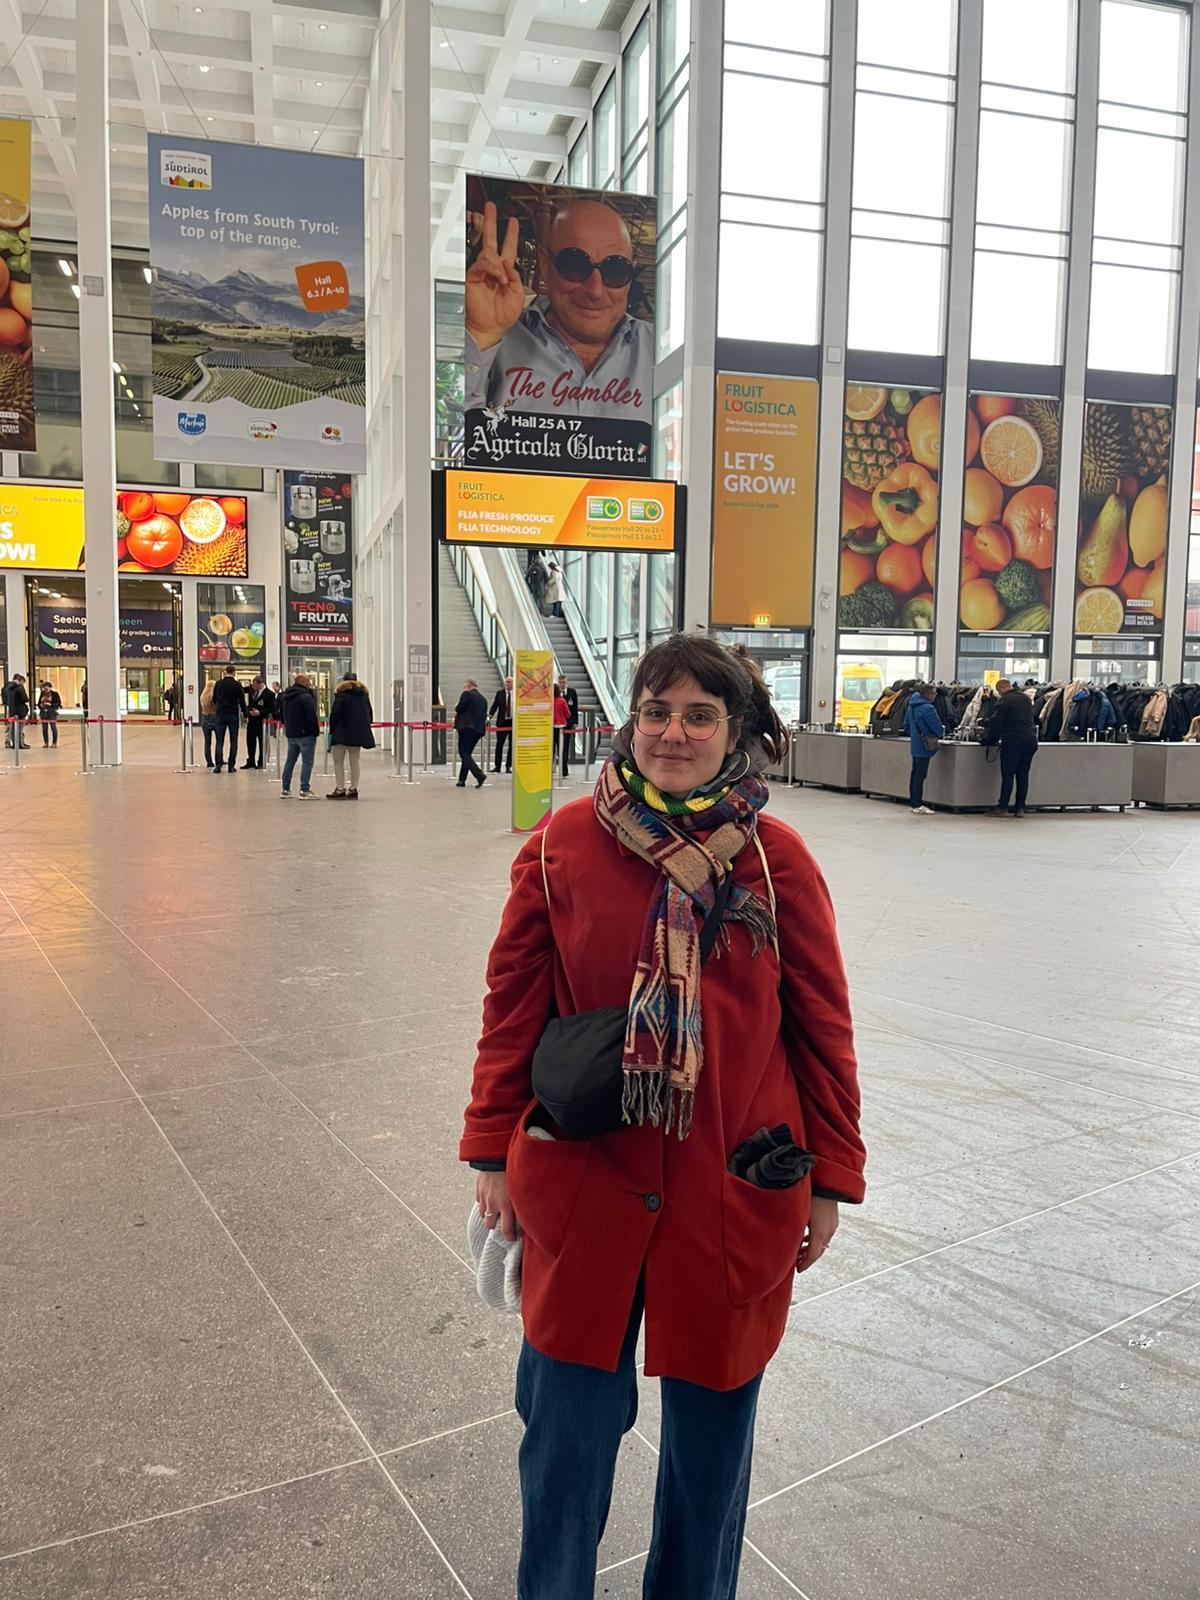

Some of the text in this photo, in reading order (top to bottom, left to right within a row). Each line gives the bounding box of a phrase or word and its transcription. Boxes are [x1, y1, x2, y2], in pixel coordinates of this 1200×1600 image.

[161, 203, 339, 235] Apples from South Tyrol:
[180, 224, 302, 250] top of the range.
[314, 275, 332, 286] Hall
[505, 366, 643, 408] The Gambler
[725, 383, 765, 398] FRUIT
[724, 399, 797, 416] LOGISTICA
[511, 415, 582, 432] Hall 25 A 17
[467, 425, 635, 463] Agricola Gloria
[458, 482, 484, 491] FRUIT
[724, 474, 796, 496] GROW!
[458, 491, 505, 502] LOGISTICA
[458, 510, 555, 523] FLIA FRESH PRODUCE
[0, 521, 14, 540] S
[458, 523, 543, 535] FLIA TECHNOLOGY
[290, 601, 336, 612] TECNO
[53, 614, 87, 626] Seeing
[299, 611, 348, 623] FRUTTA
[53, 627, 85, 635] Experience
